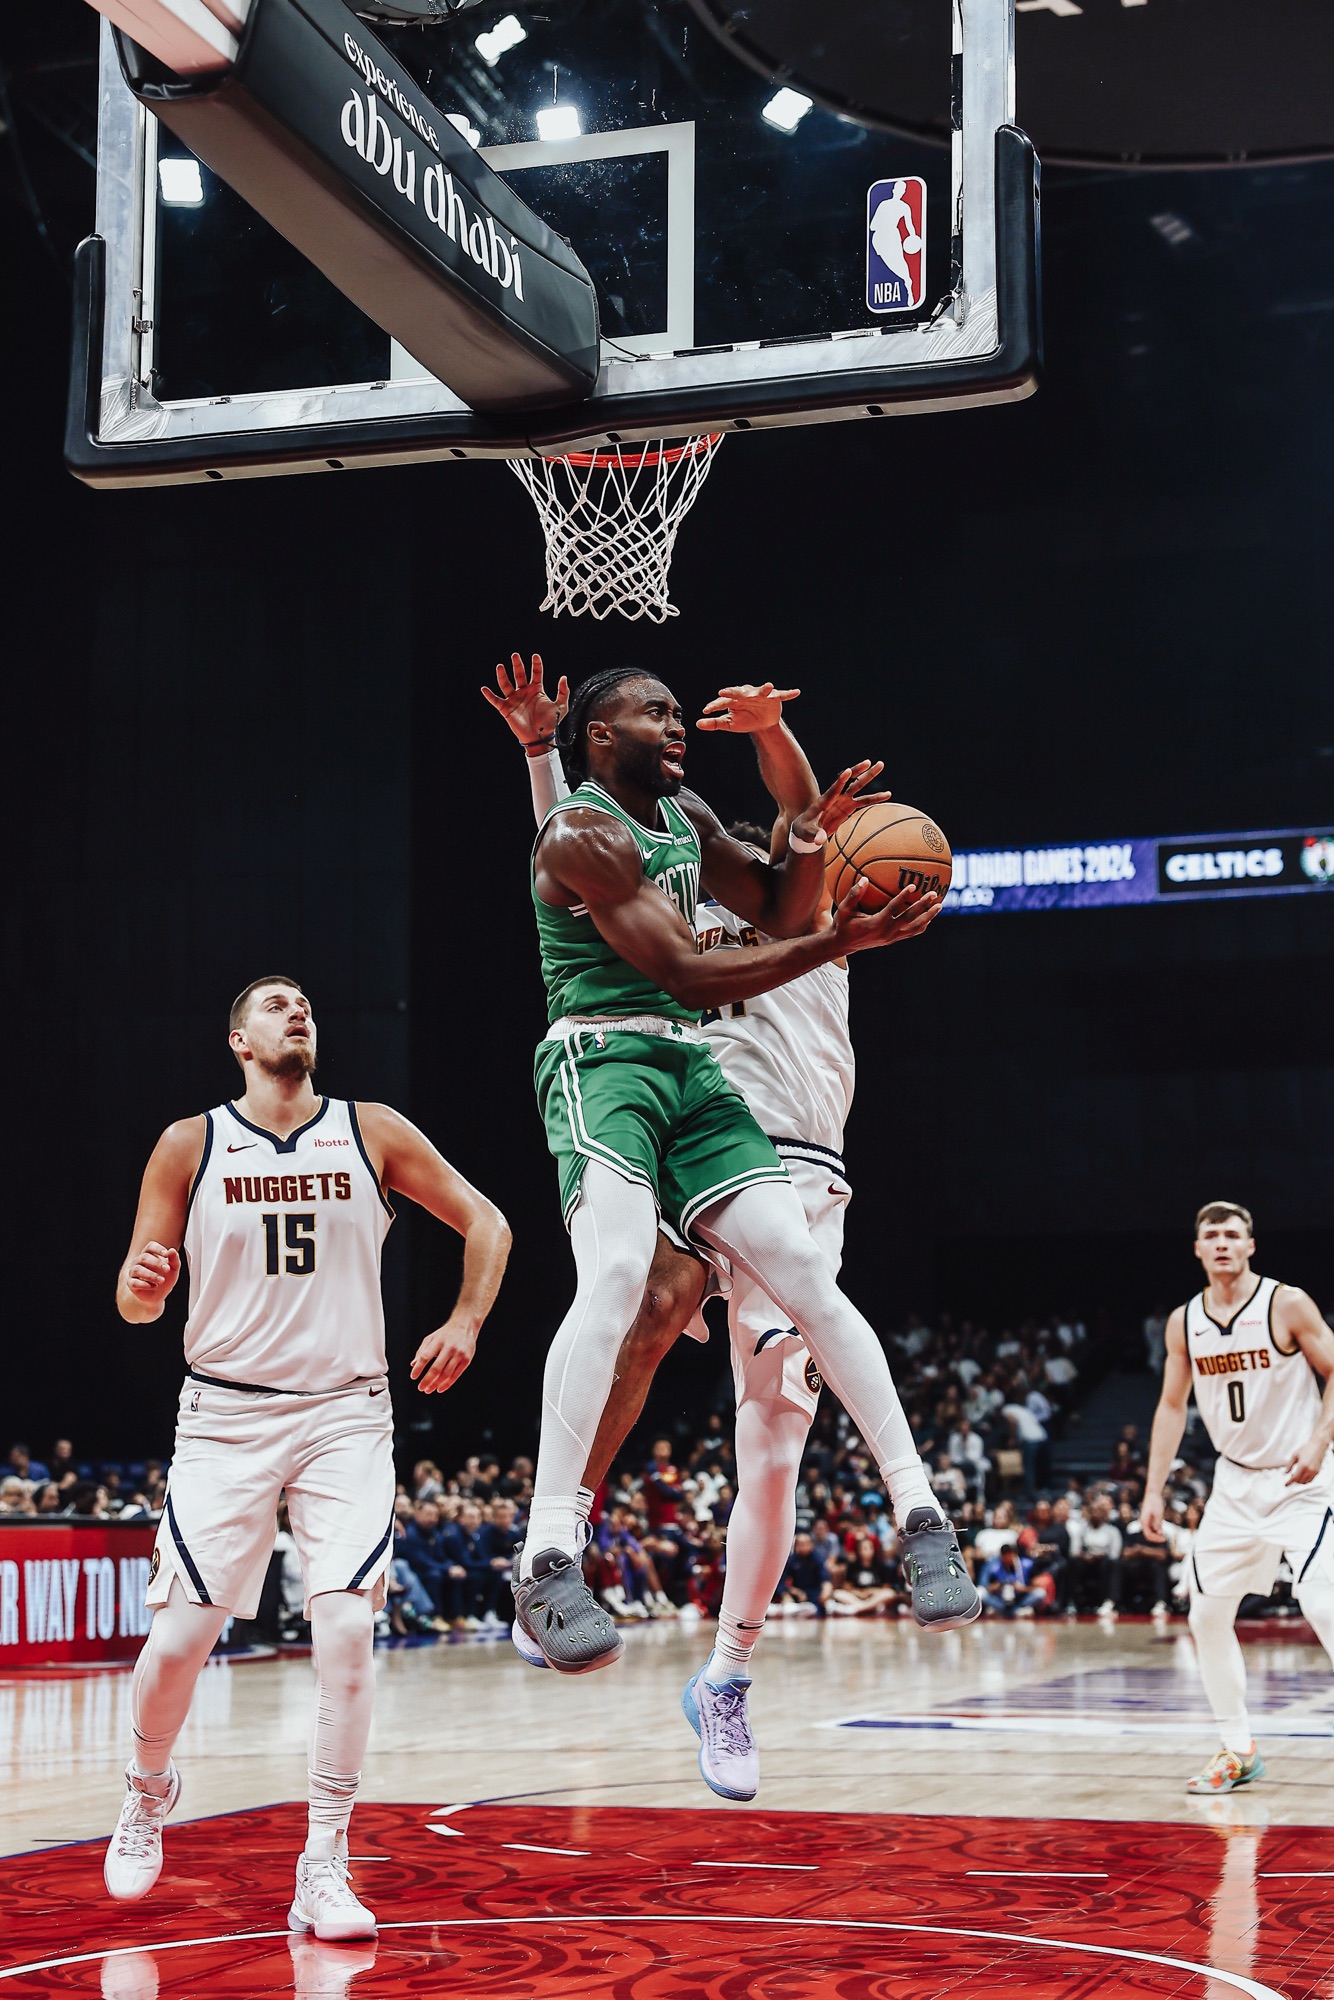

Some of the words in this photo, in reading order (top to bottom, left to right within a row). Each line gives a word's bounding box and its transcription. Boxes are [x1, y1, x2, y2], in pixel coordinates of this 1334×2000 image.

[344, 32, 440, 152] experience
[340, 88, 416, 206] abu
[423, 162, 525, 303] dhabi
[874, 281, 902, 304] NBA
[1023, 847, 1083, 887] GAMES
[1083, 844, 1136, 882] 2024
[1165, 848, 1285, 883] CELTICS
[313, 1139, 350, 1148] ibotta
[223, 1172, 352, 1205] NUGGETS
[261, 1212, 317, 1278] 15
[1194, 1349, 1271, 1376] NUGGETS
[1227, 1381, 1246, 1423] 0
[24, 1559, 81, 1644] WAY
[83, 1556, 116, 1640] TO
